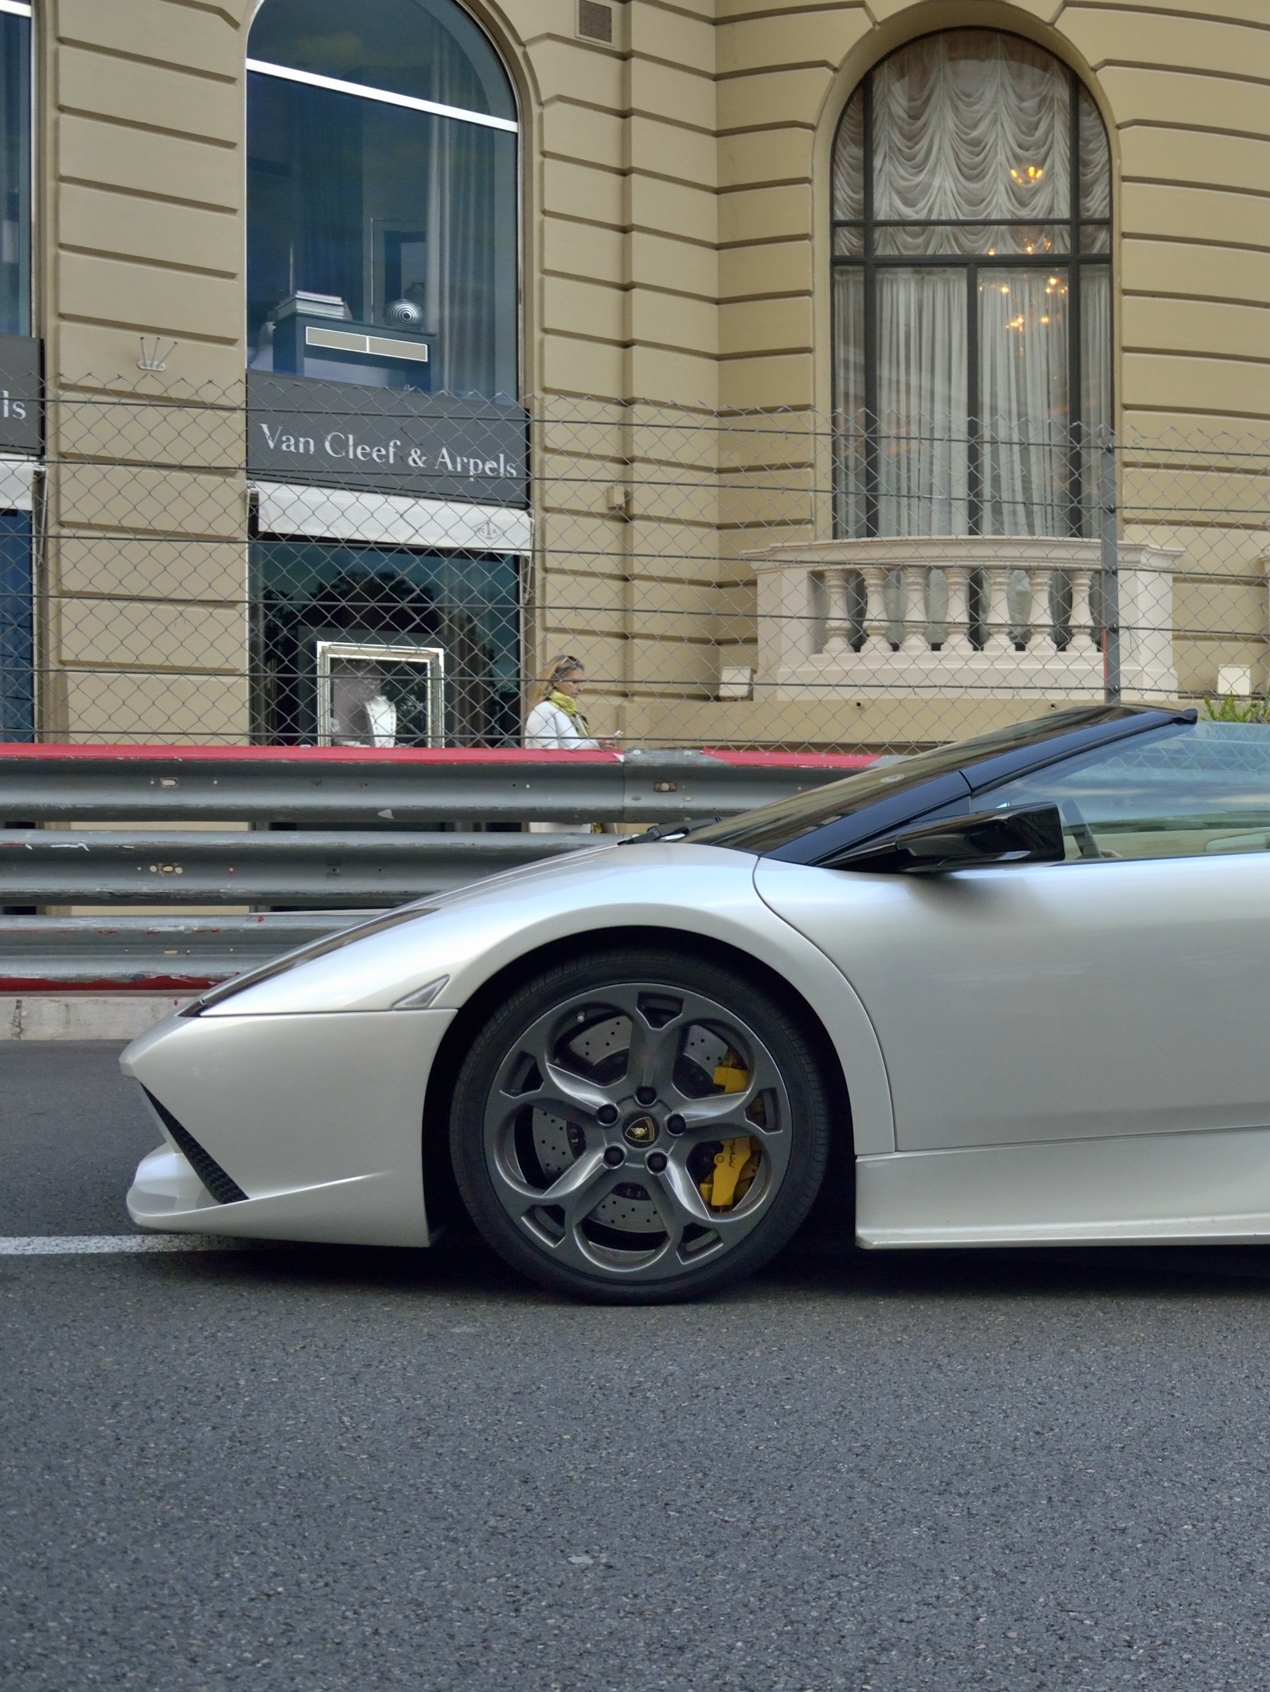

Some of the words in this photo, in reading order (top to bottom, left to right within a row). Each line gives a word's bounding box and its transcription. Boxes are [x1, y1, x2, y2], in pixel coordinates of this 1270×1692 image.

[259, 423, 315, 454] Van
[325, 432, 401, 464] Cleef
[408, 448, 427, 468] &
[435, 447, 517, 481] Arpels
